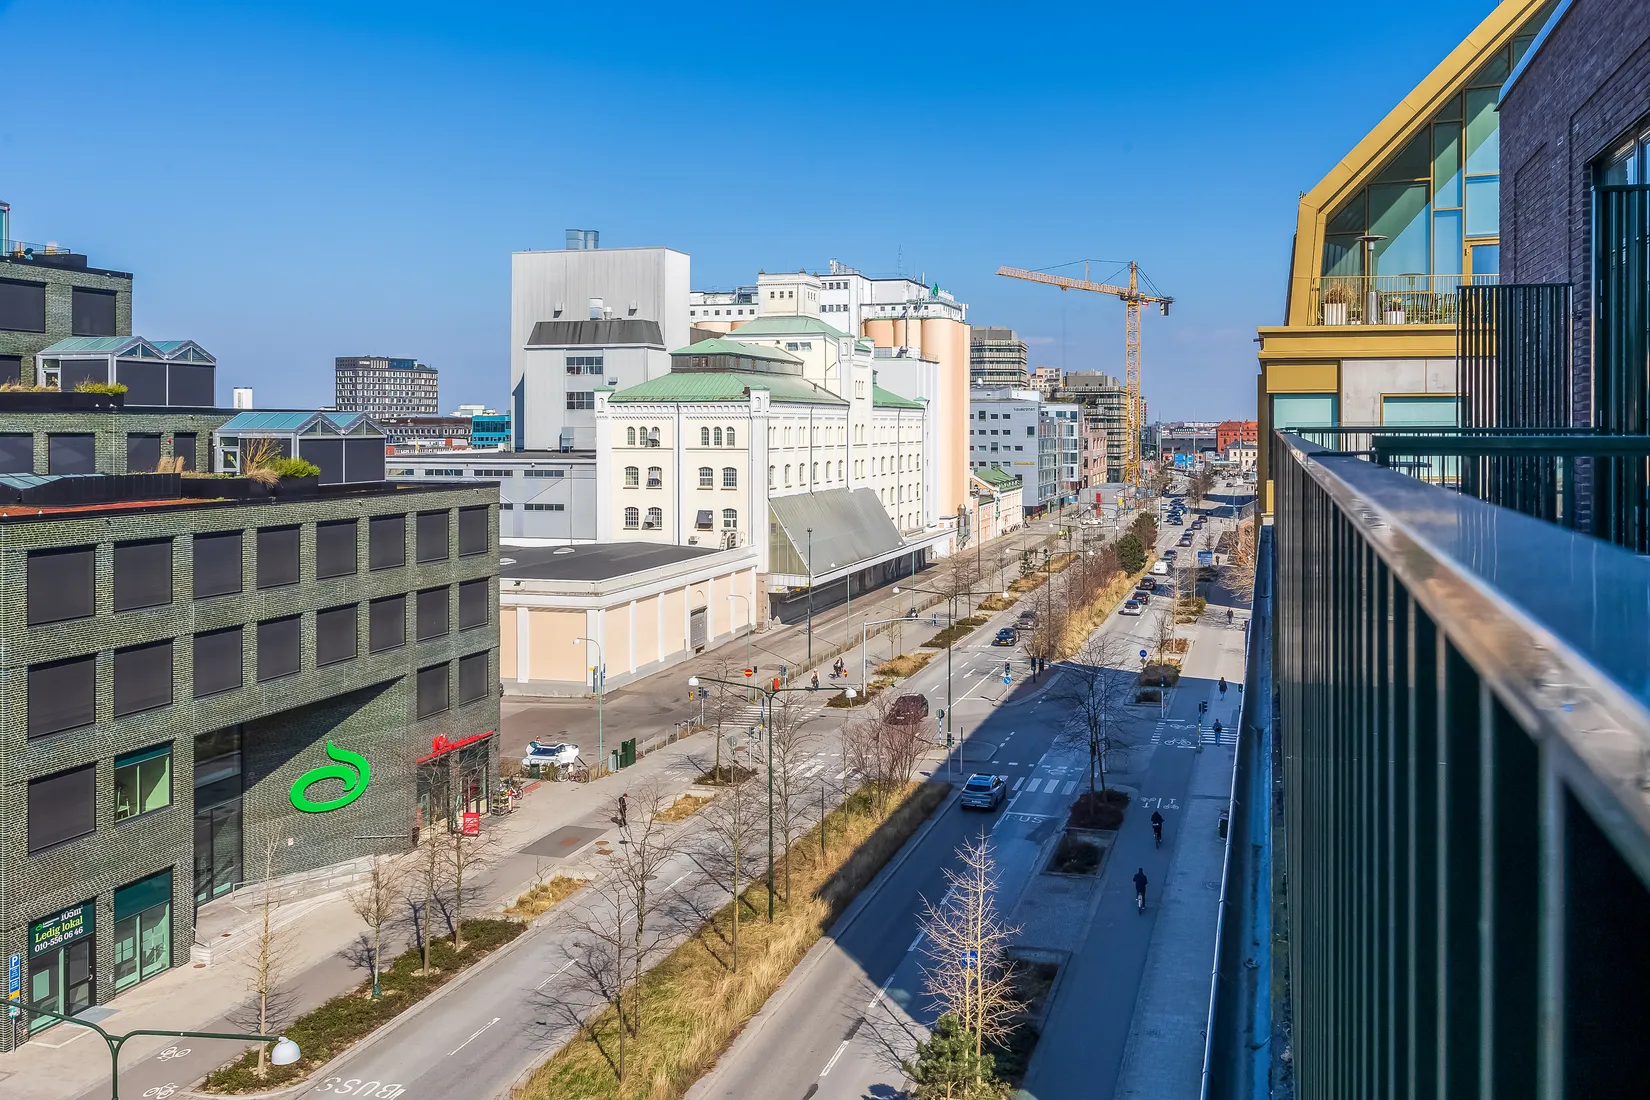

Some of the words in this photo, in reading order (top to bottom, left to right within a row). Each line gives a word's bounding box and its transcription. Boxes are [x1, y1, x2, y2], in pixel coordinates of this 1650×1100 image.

[34, 935, 63, 953] 010-556
[63, 930, 74, 940] 06
[73, 926, 84, 936] 46
[35, 926, 61, 943] Ledig
[61, 915, 83, 932] lokal
[11, 955, 18, 967] P
[315, 1077, 403, 1099] BUSS
